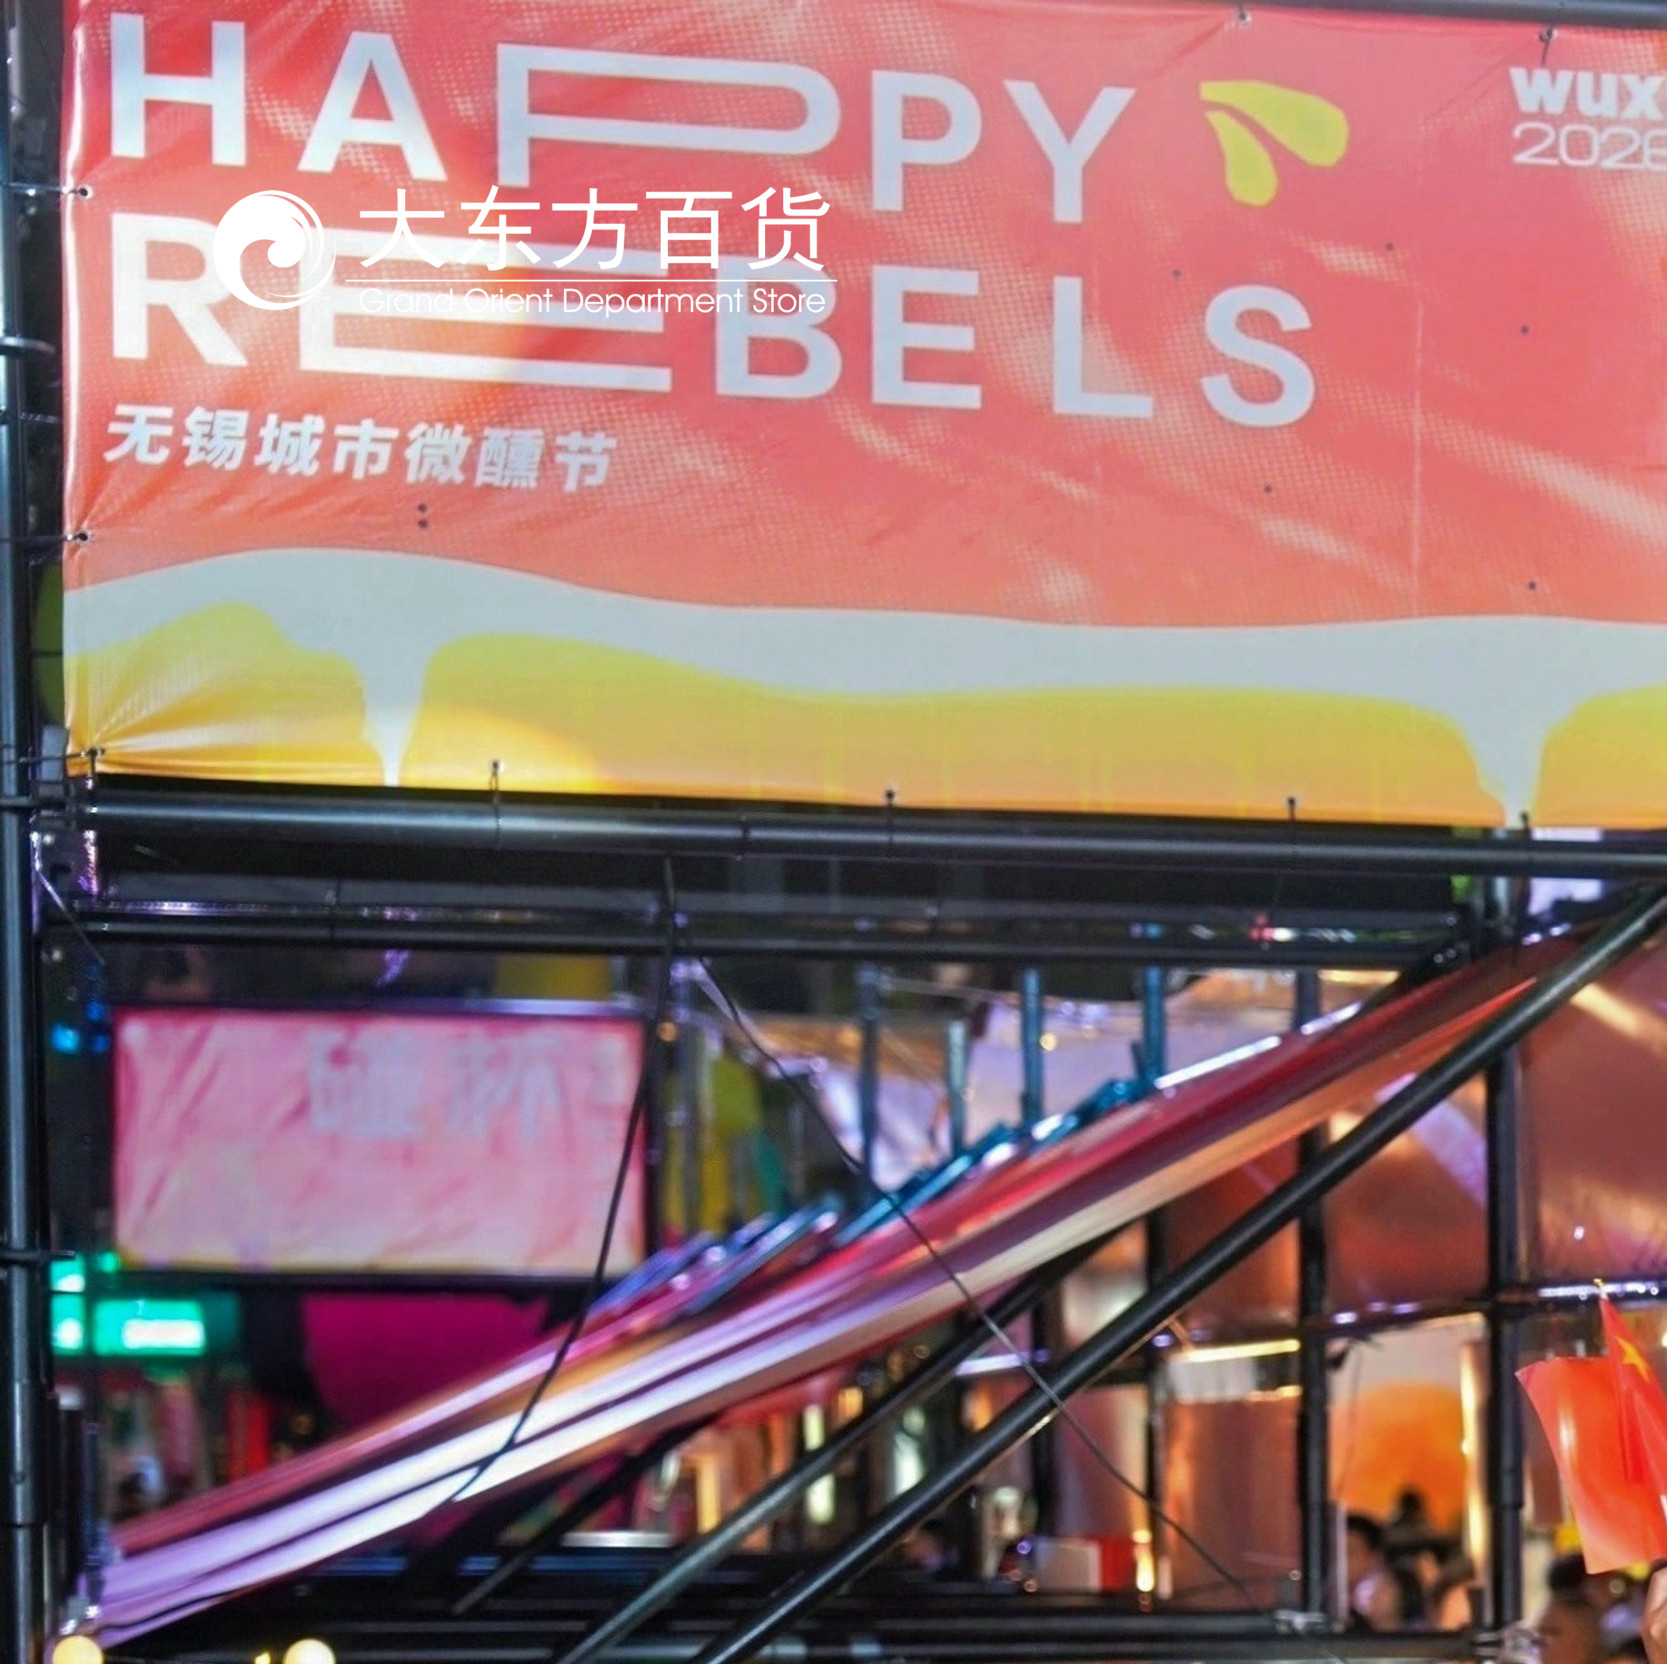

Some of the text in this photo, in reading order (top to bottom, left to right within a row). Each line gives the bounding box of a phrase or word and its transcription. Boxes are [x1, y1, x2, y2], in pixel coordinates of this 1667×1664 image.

[110, 12, 1135, 223] HAPPY
[111, 212, 1316, 428] REBELS
[103, 402, 618, 492] 无锡城市微醺节
